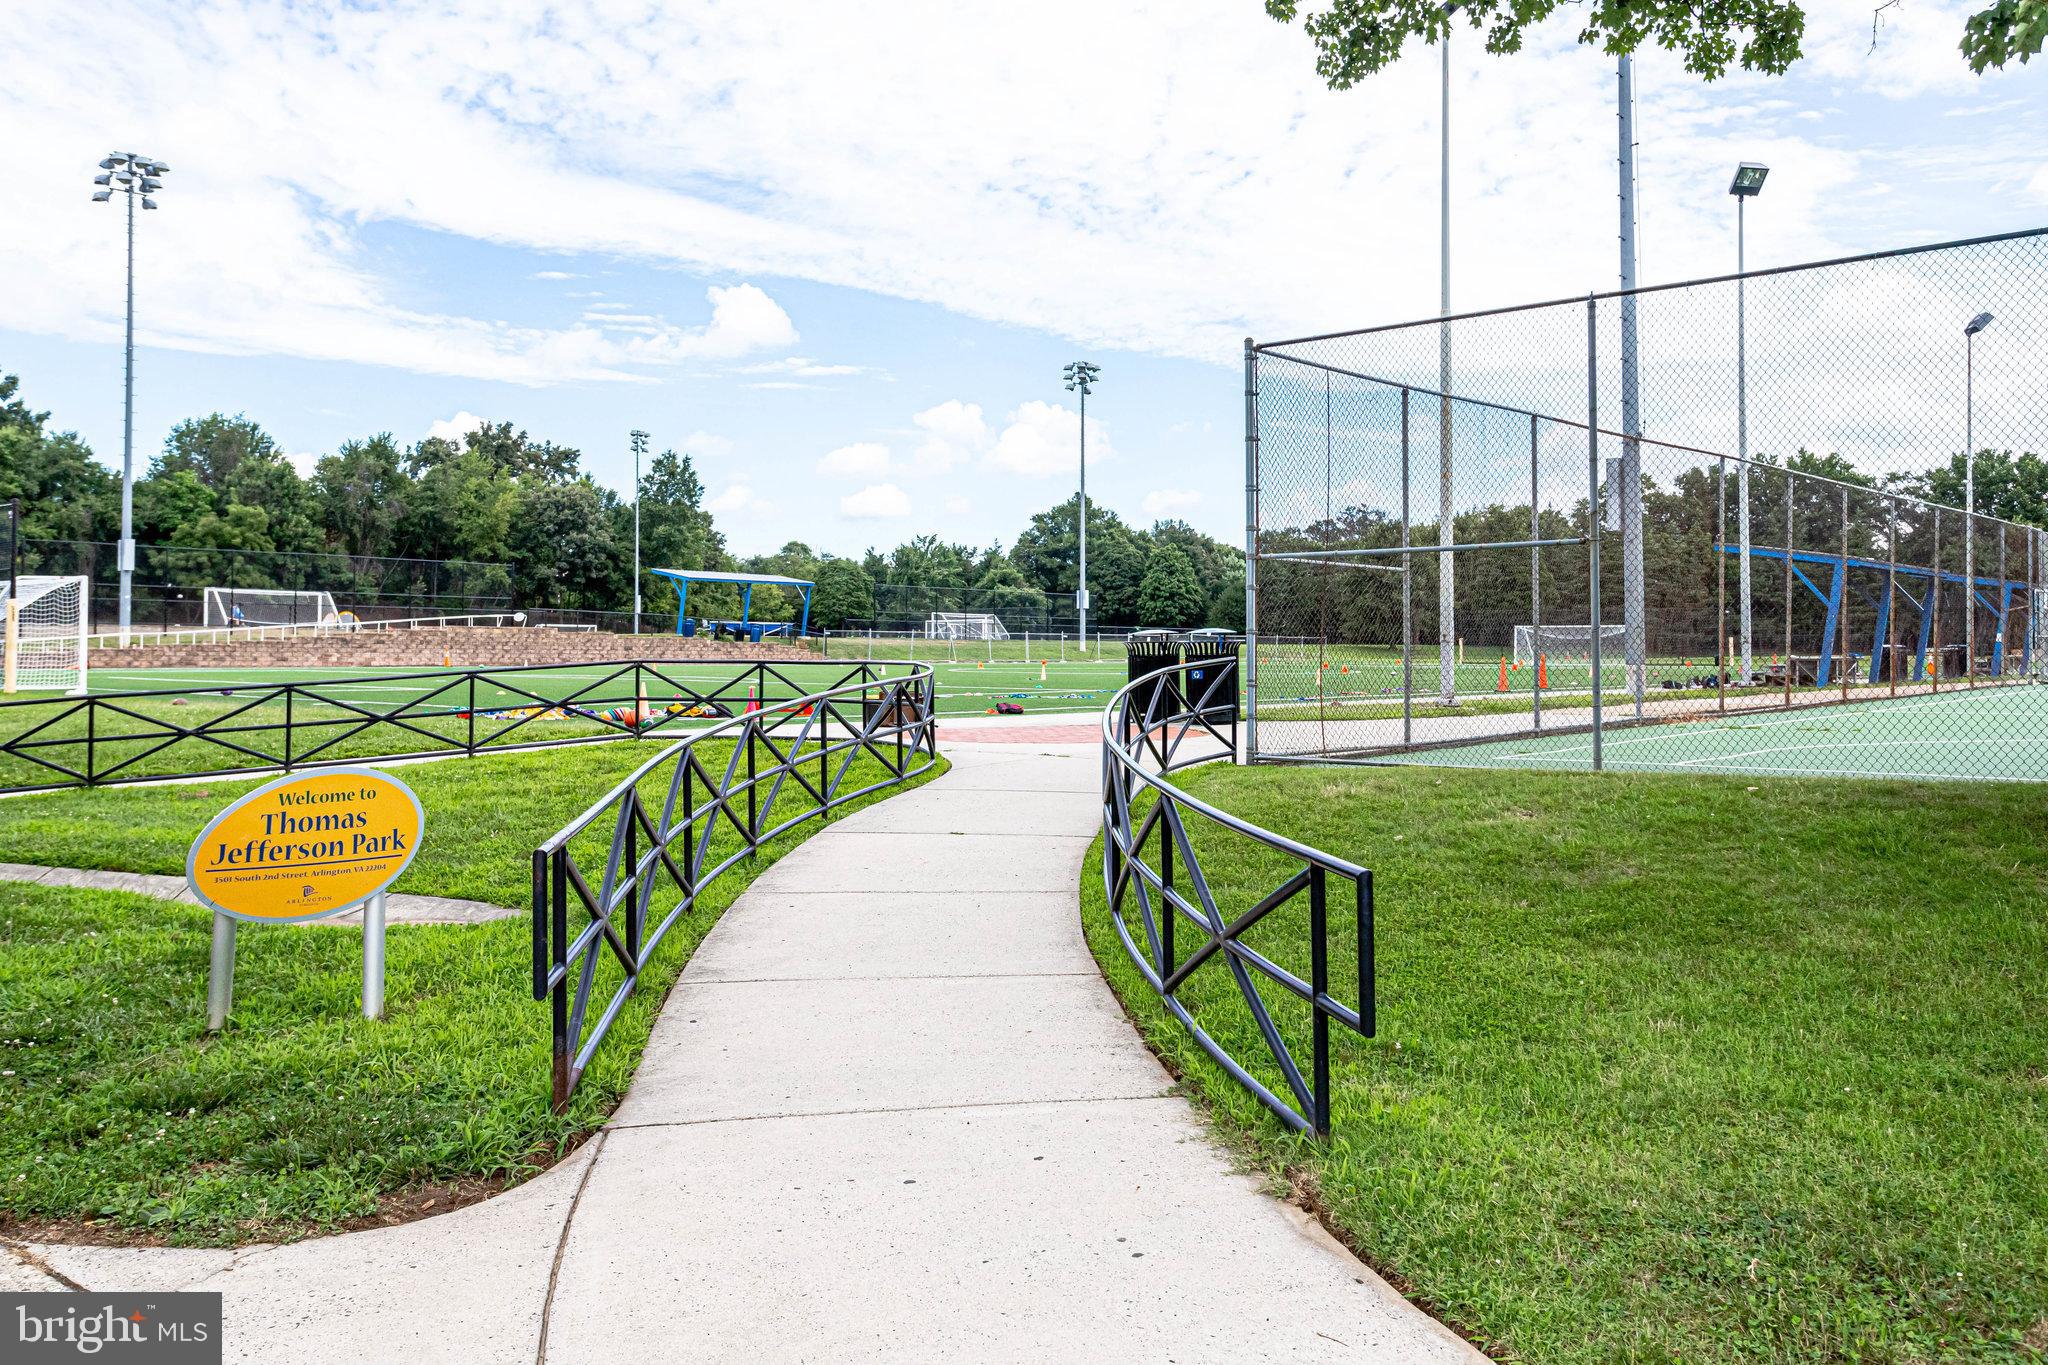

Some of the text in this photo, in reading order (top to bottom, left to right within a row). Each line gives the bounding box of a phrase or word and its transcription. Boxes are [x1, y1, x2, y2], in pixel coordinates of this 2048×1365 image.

[279, 787, 377, 807] Welcome to
[261, 810, 367, 835] Thomas
[210, 828, 406, 866] Jefferson Park
[235, 874, 261, 882] South
[263, 873, 280, 881] 2nd
[354, 865, 364, 873] VA
[365, 863, 387, 872] 22204
[286, 896, 333, 904] ARLINGTON
